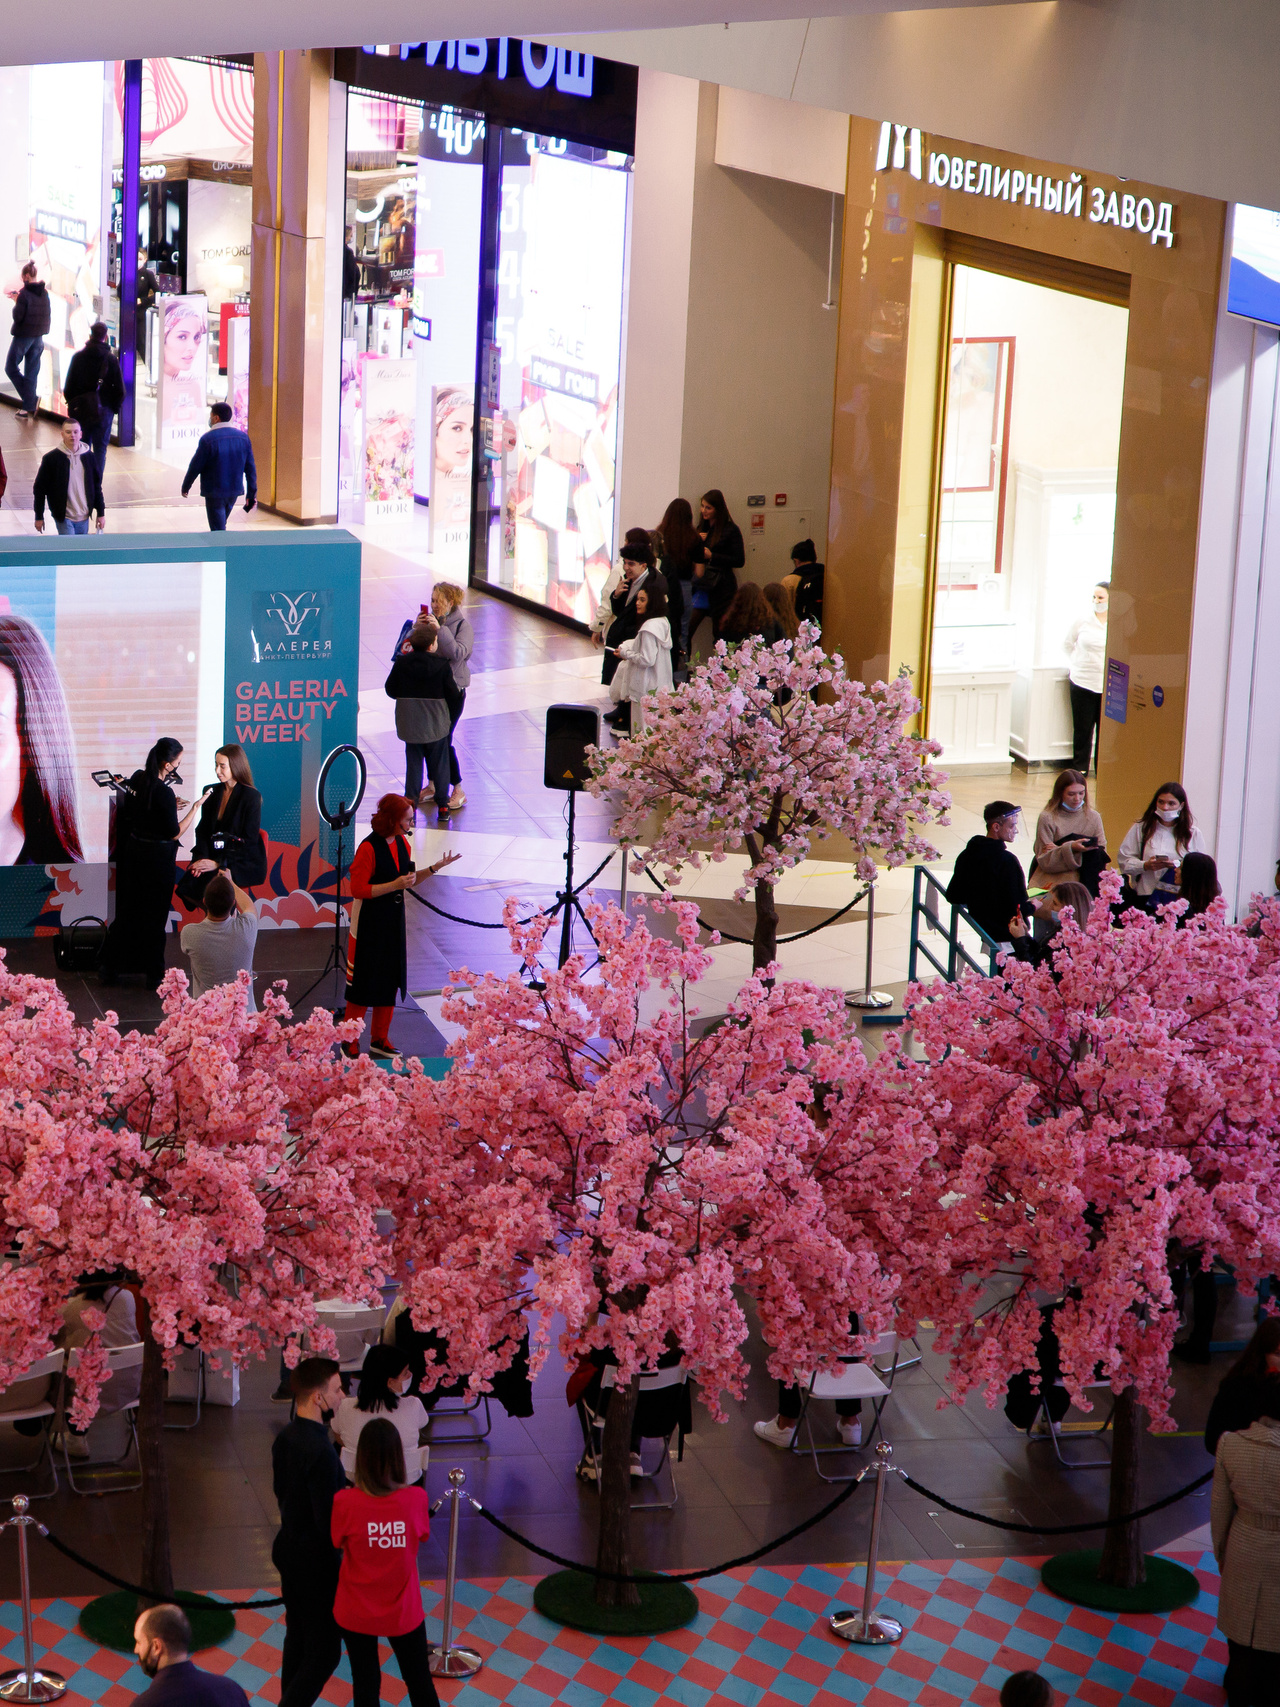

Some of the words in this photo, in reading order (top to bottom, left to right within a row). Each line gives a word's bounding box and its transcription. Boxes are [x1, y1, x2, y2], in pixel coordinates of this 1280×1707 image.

[928, 152, 1083, 218] ЮВЕЛИРНЫЙ
[1089, 186, 1174, 248] ЗАВОД
[201, 248, 224, 260] TOM
[225, 245, 252, 257] FORD
[390, 269, 403, 278] TOM
[403, 268, 415, 276] FOR
[547, 327, 585, 361] SALE
[172, 427, 200, 439] DIOR
[376, 503, 409, 515] DIOR
[445, 531, 469, 543] DIO
[255, 640, 332, 652] АЛЕРЕЯ
[254, 652, 332, 661] АНКТ-ПЕТЕРБУРГ
[235, 679, 348, 700] GALERIA
[236, 701, 338, 722] BEAUTY
[235, 723, 311, 743] WEEK
[367, 1521, 406, 1535] РИВ
[368, 1535, 406, 1549] ГОШ
